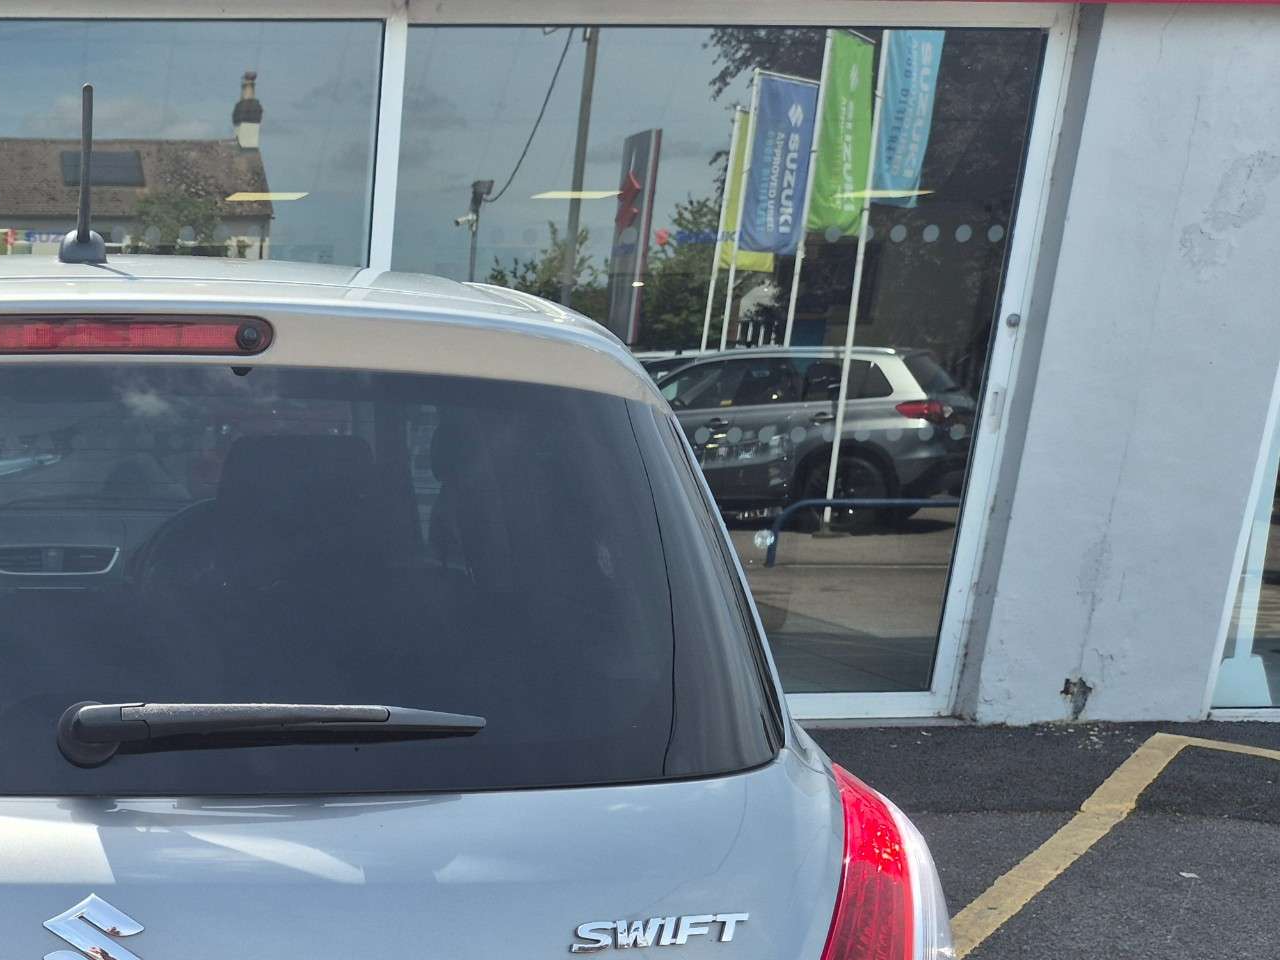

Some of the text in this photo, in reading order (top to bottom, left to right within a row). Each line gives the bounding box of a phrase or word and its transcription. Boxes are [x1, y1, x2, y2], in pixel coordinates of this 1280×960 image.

[902, 41, 933, 178] SUZUKI
[778, 132, 801, 234] SUZUKI
[569, 912, 749, 953] SWIFT
